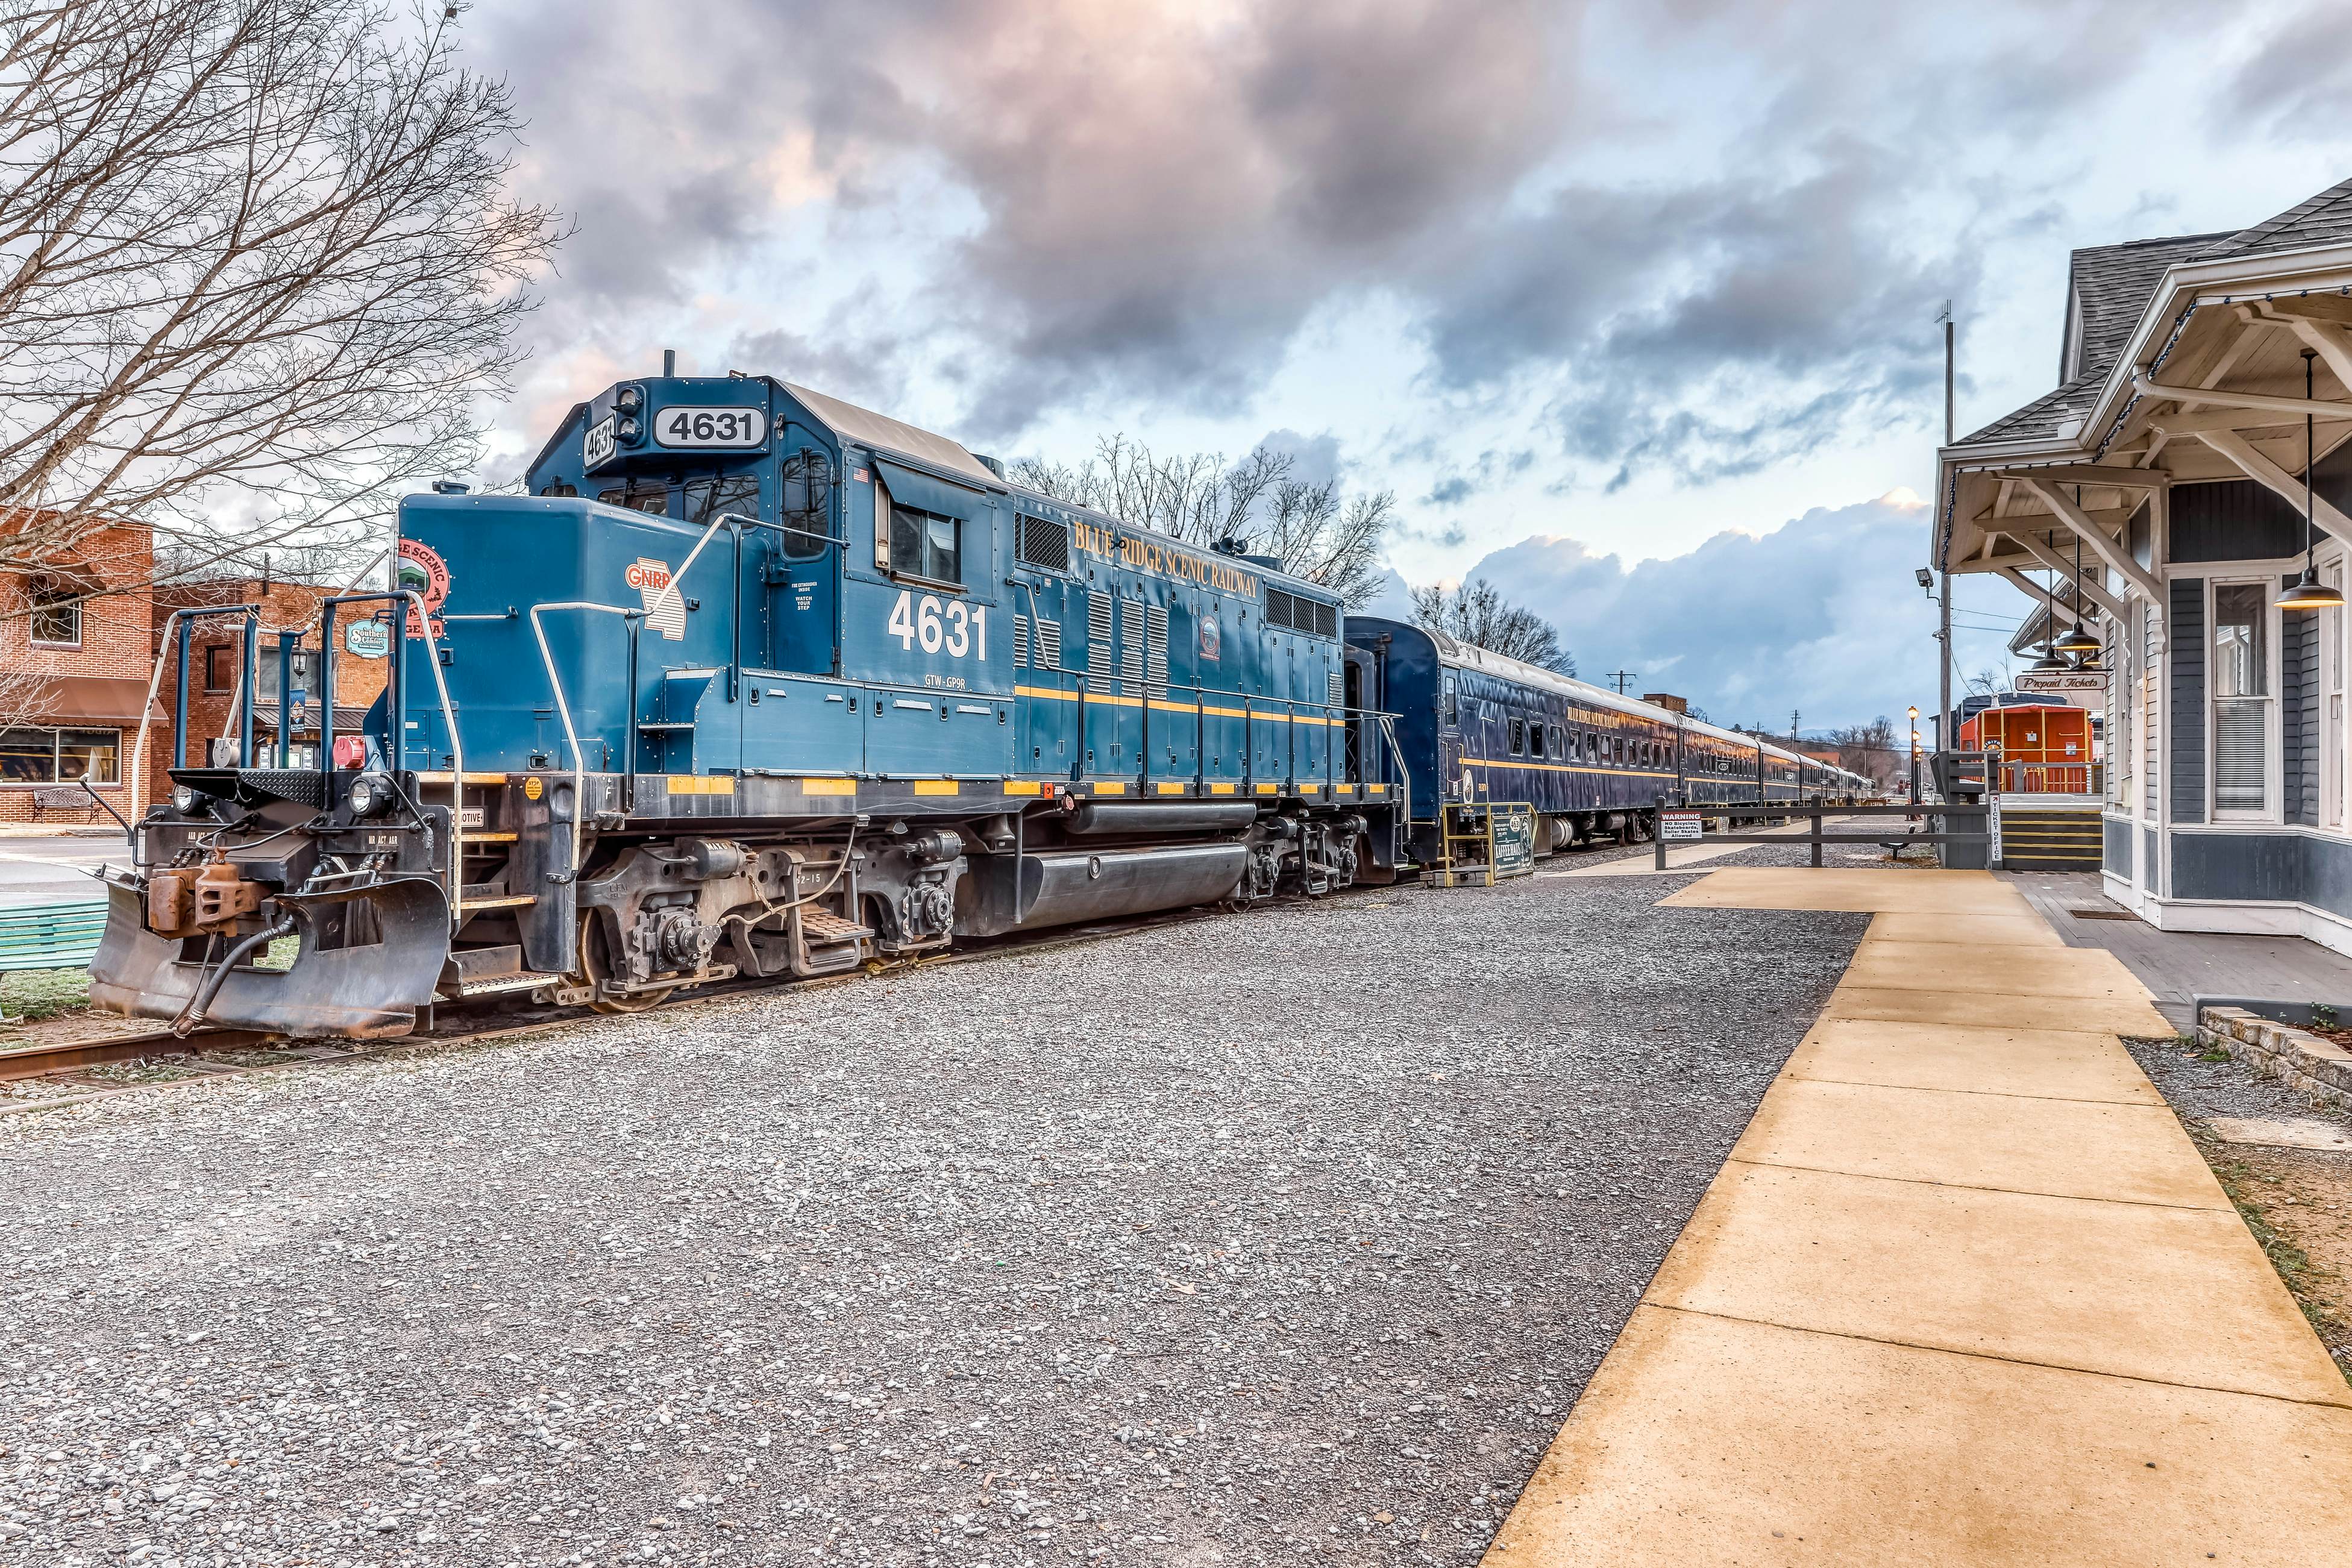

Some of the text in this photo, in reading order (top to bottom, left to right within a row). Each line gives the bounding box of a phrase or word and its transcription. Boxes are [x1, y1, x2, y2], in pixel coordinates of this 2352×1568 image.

[588, 421, 612, 460] 4631
[669, 412, 751, 441] 4631
[412, 547, 445, 582] SCENIC
[1074, 521, 1258, 598] BLUE RIDGE SCENIC RAILWAY
[351, 628, 387, 644] Southern
[888, 590, 986, 662] 4631
[925, 674, 941, 686] GTW
[947, 676, 965, 689] GP9R
[2024, 677, 2098, 689] Prepaid Tickets
[377, 835, 386, 844] ACT
